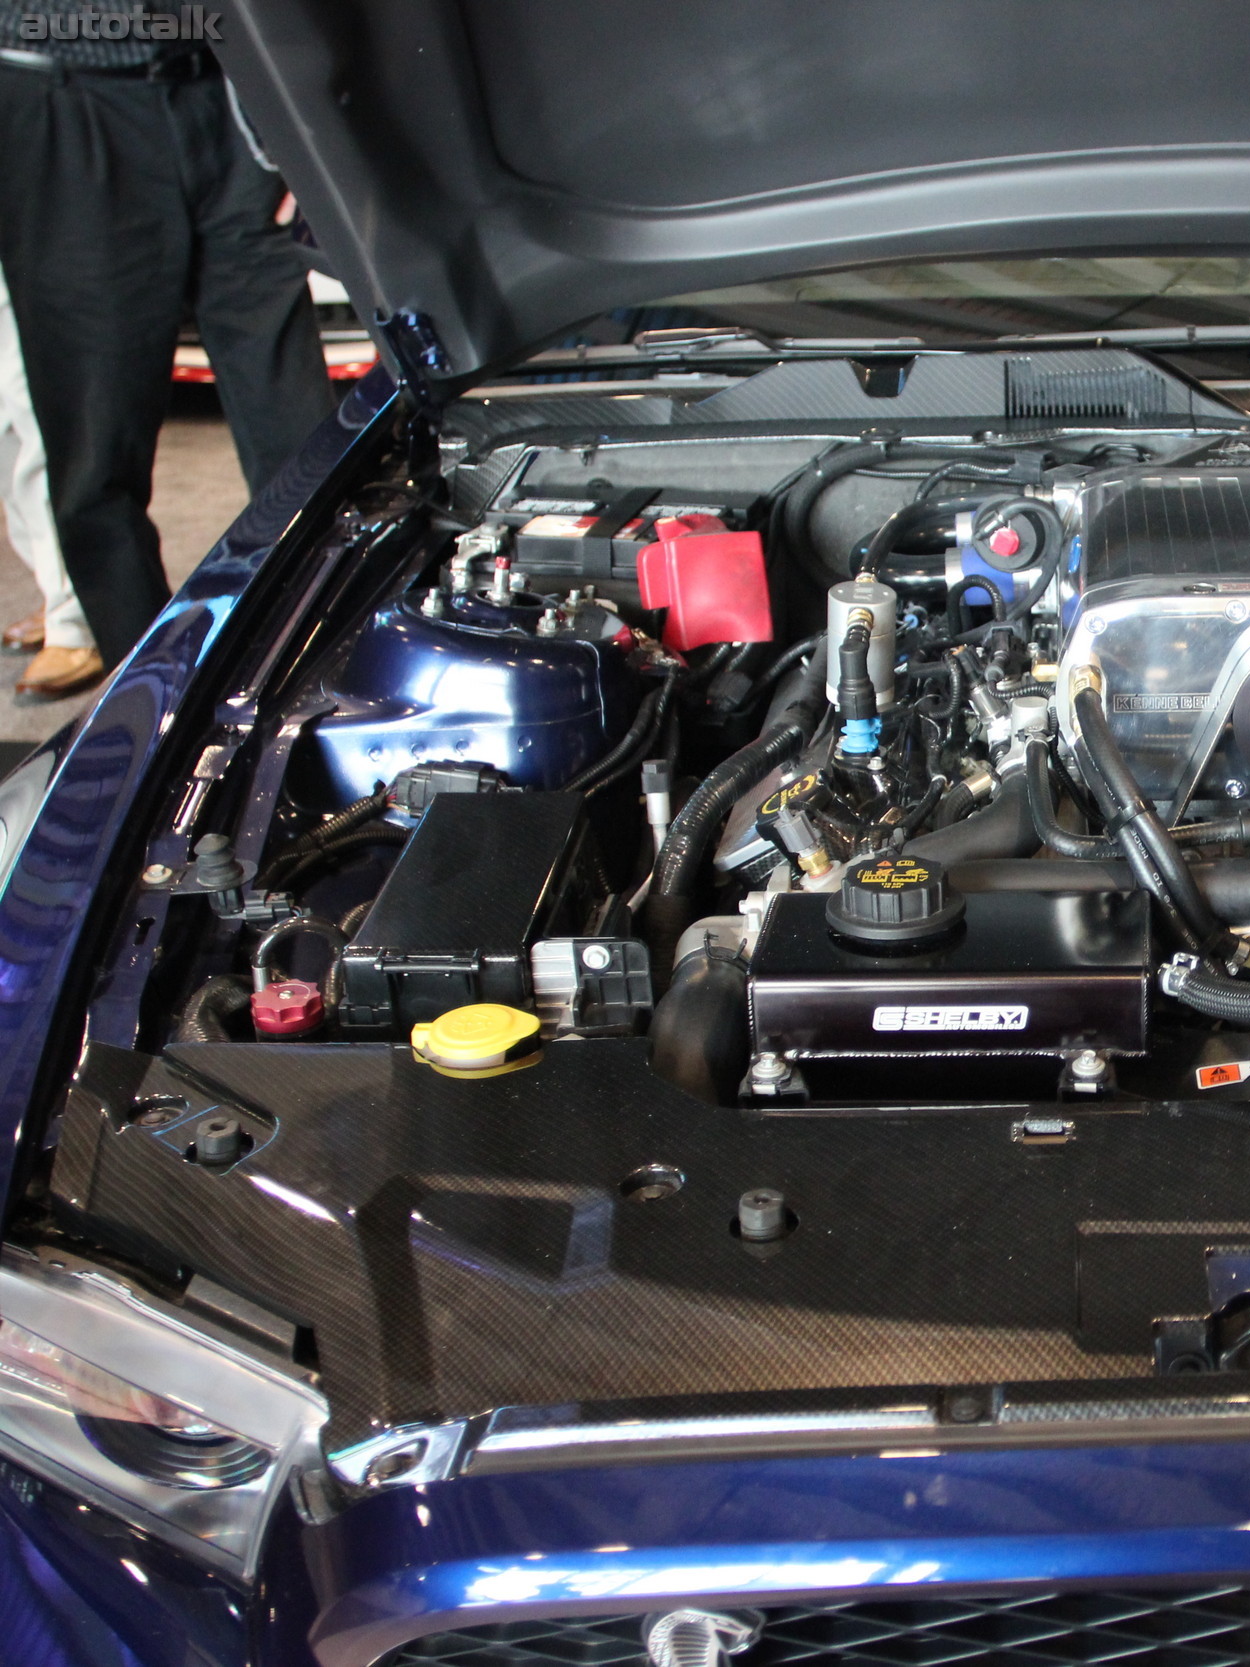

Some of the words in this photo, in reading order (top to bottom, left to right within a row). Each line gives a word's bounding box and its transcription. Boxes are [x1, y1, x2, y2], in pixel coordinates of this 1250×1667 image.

[1116, 696, 1179, 710] KENNE
[1130, 828, 1149, 860] MADE
[905, 1011, 1021, 1026] SHELBY
